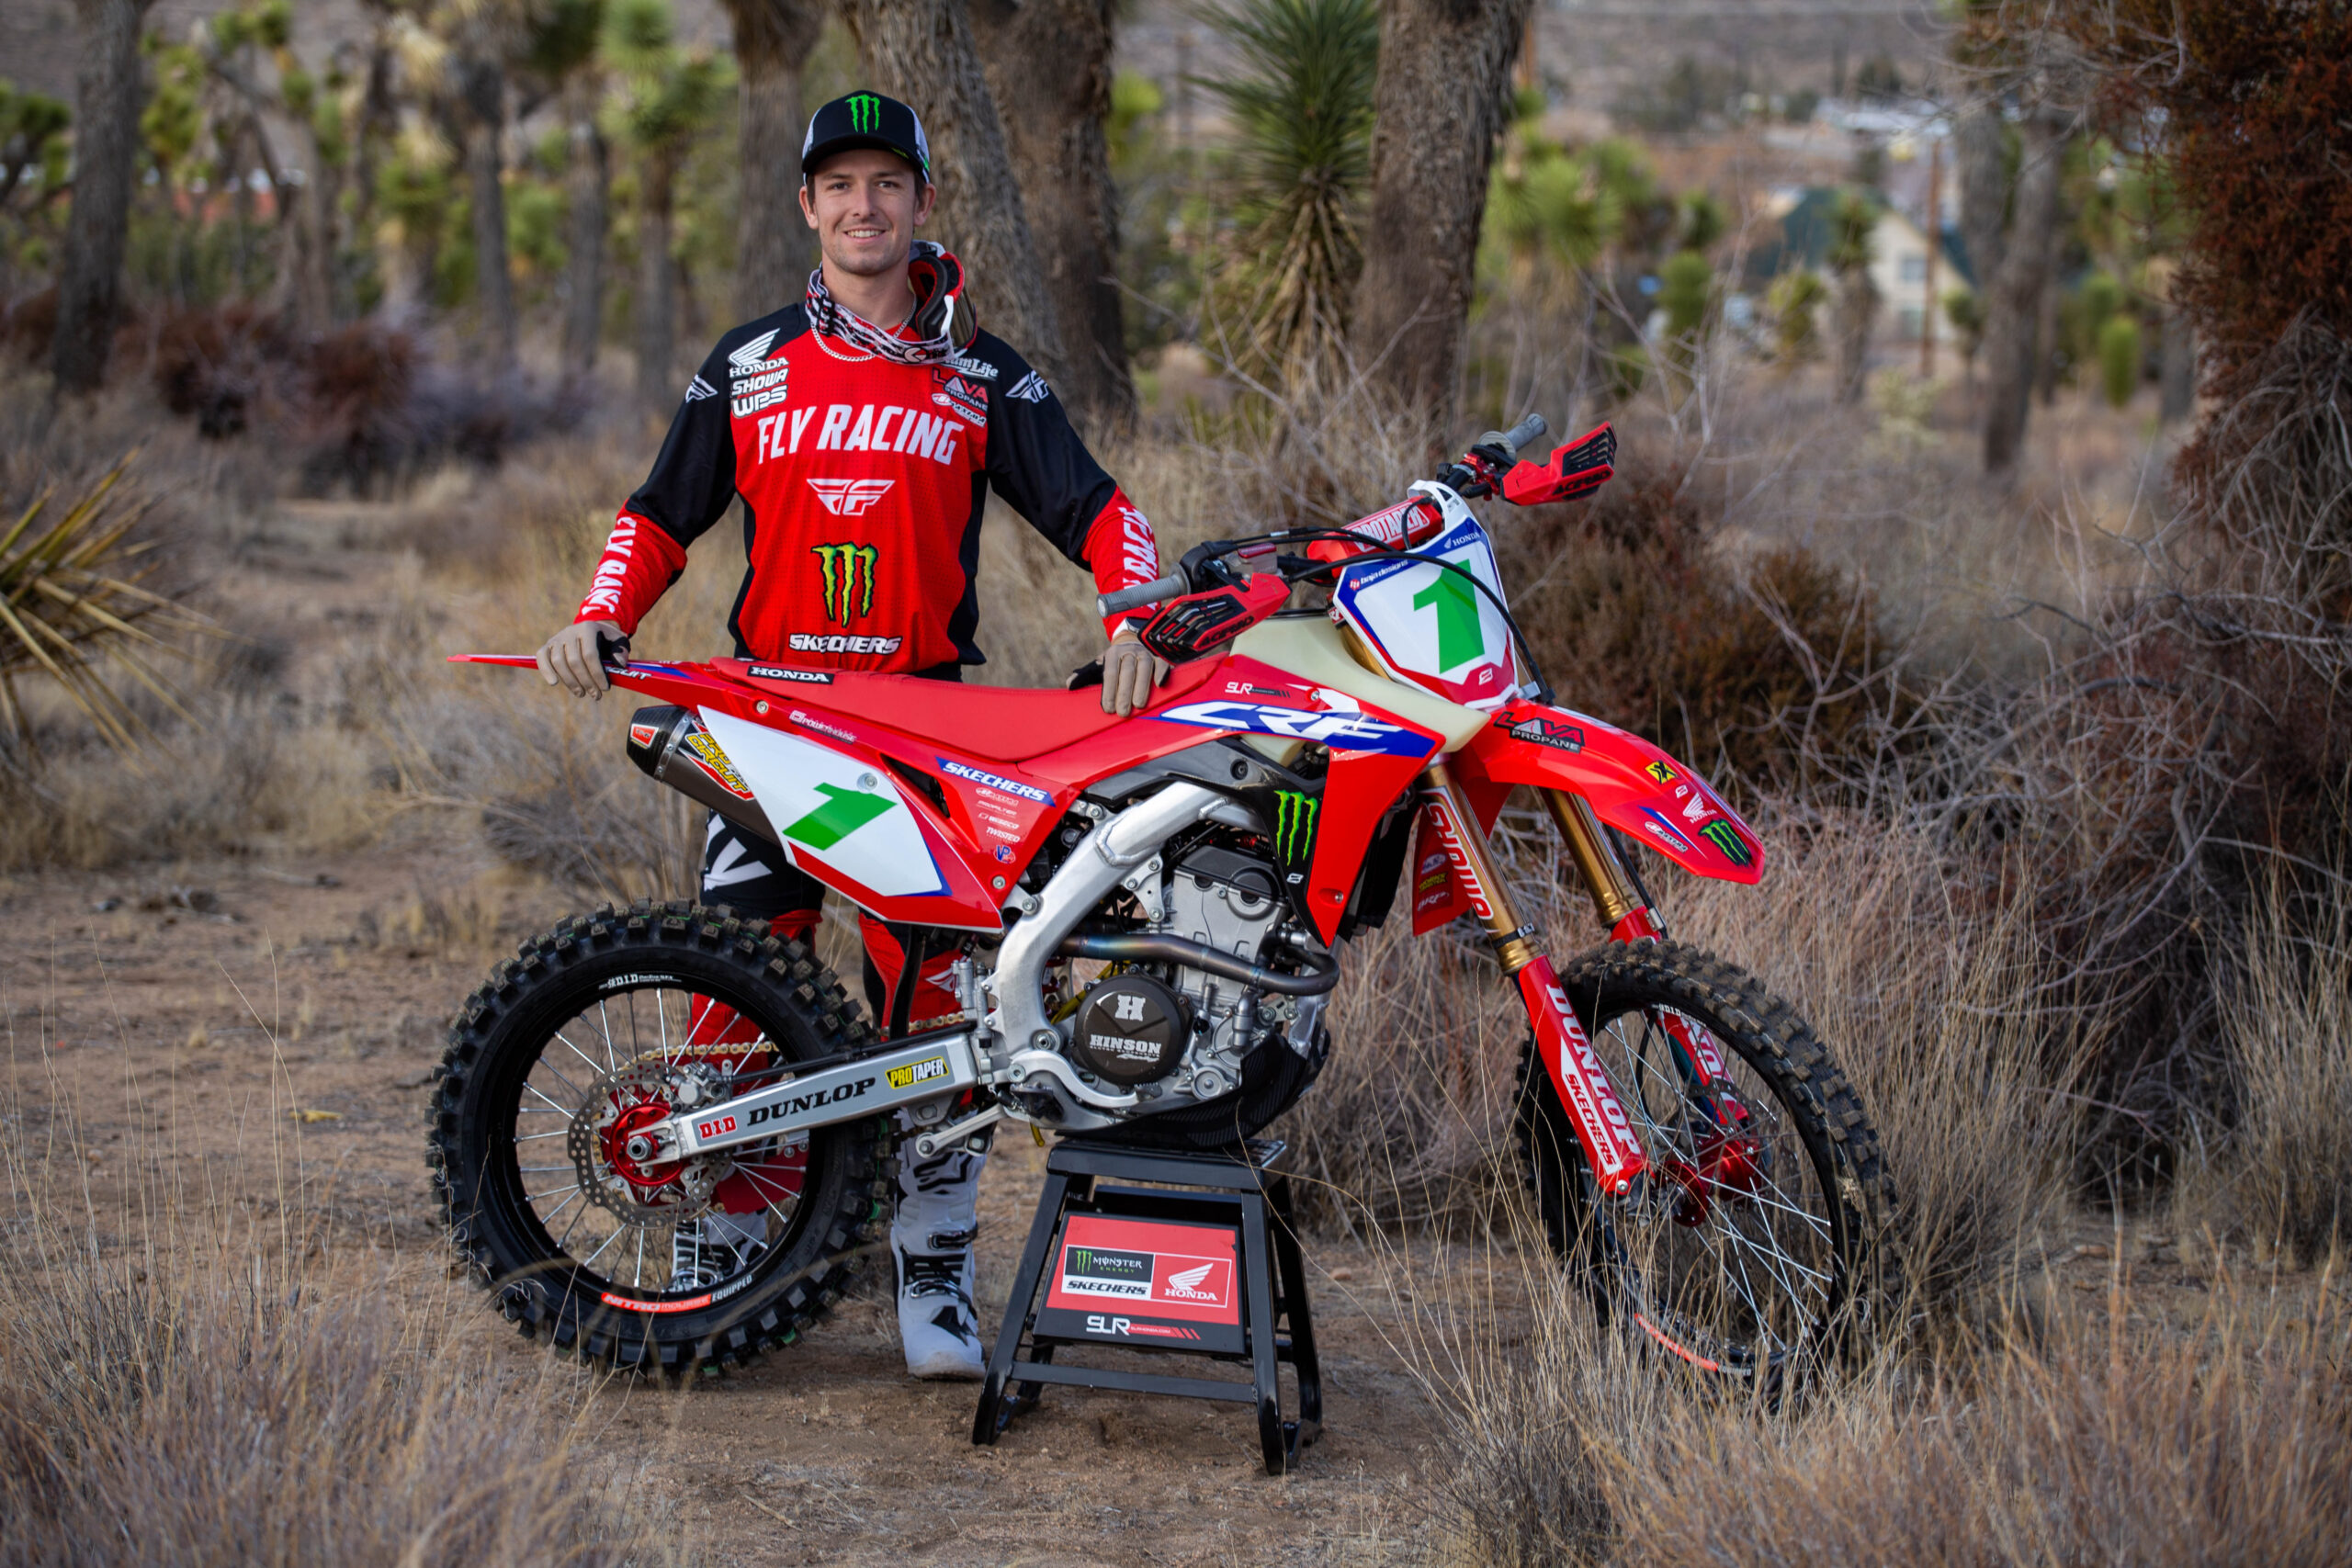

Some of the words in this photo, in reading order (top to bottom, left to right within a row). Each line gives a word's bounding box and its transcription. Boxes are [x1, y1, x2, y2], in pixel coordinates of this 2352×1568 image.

[729, 356, 789, 378] HONDA
[731, 367, 789, 396] SHOWA
[933, 368, 989, 404] LAVA
[732, 384, 788, 417] WPS
[944, 386, 989, 412] PROPANE
[757, 406, 817, 465] FLY
[816, 404, 965, 466] RACING
[1453, 531, 1480, 547] HONDA
[1413, 558, 1486, 675] 1
[788, 634, 902, 655] SKECHERS
[751, 666, 831, 682] HONDA
[1225, 682, 1253, 694] SLR
[1161, 701, 1404, 741] CRF
[1494, 712, 1585, 746] LAVA
[1511, 728, 1581, 751] PROPANE
[687, 735, 749, 792] CIRCUIT
[942, 761, 1048, 802] SKECHERS
[782, 783, 899, 851] 1
[1689, 808, 1718, 824] HONDA
[986, 827, 1021, 843] TWISTED
[996, 845, 1012, 862] VP
[1114, 994, 1146, 1021] H
[1089, 1033, 1162, 1055] HINSON
[889, 1058, 944, 1088] PROTAPER
[1545, 984, 1641, 1155] DUNLOP
[747, 1077, 876, 1126] DUNLOP
[698, 1116, 737, 1139] D.I.D
[1565, 1073, 1617, 1166] SKECHERS
[1092, 1256, 1143, 1269] MONSTER
[711, 1274, 752, 1303] EQUIPPED
[1066, 1280, 1148, 1295] SKECHERS
[1164, 1287, 1218, 1301] HONDA
[1086, 1314, 1130, 1337] SLR
